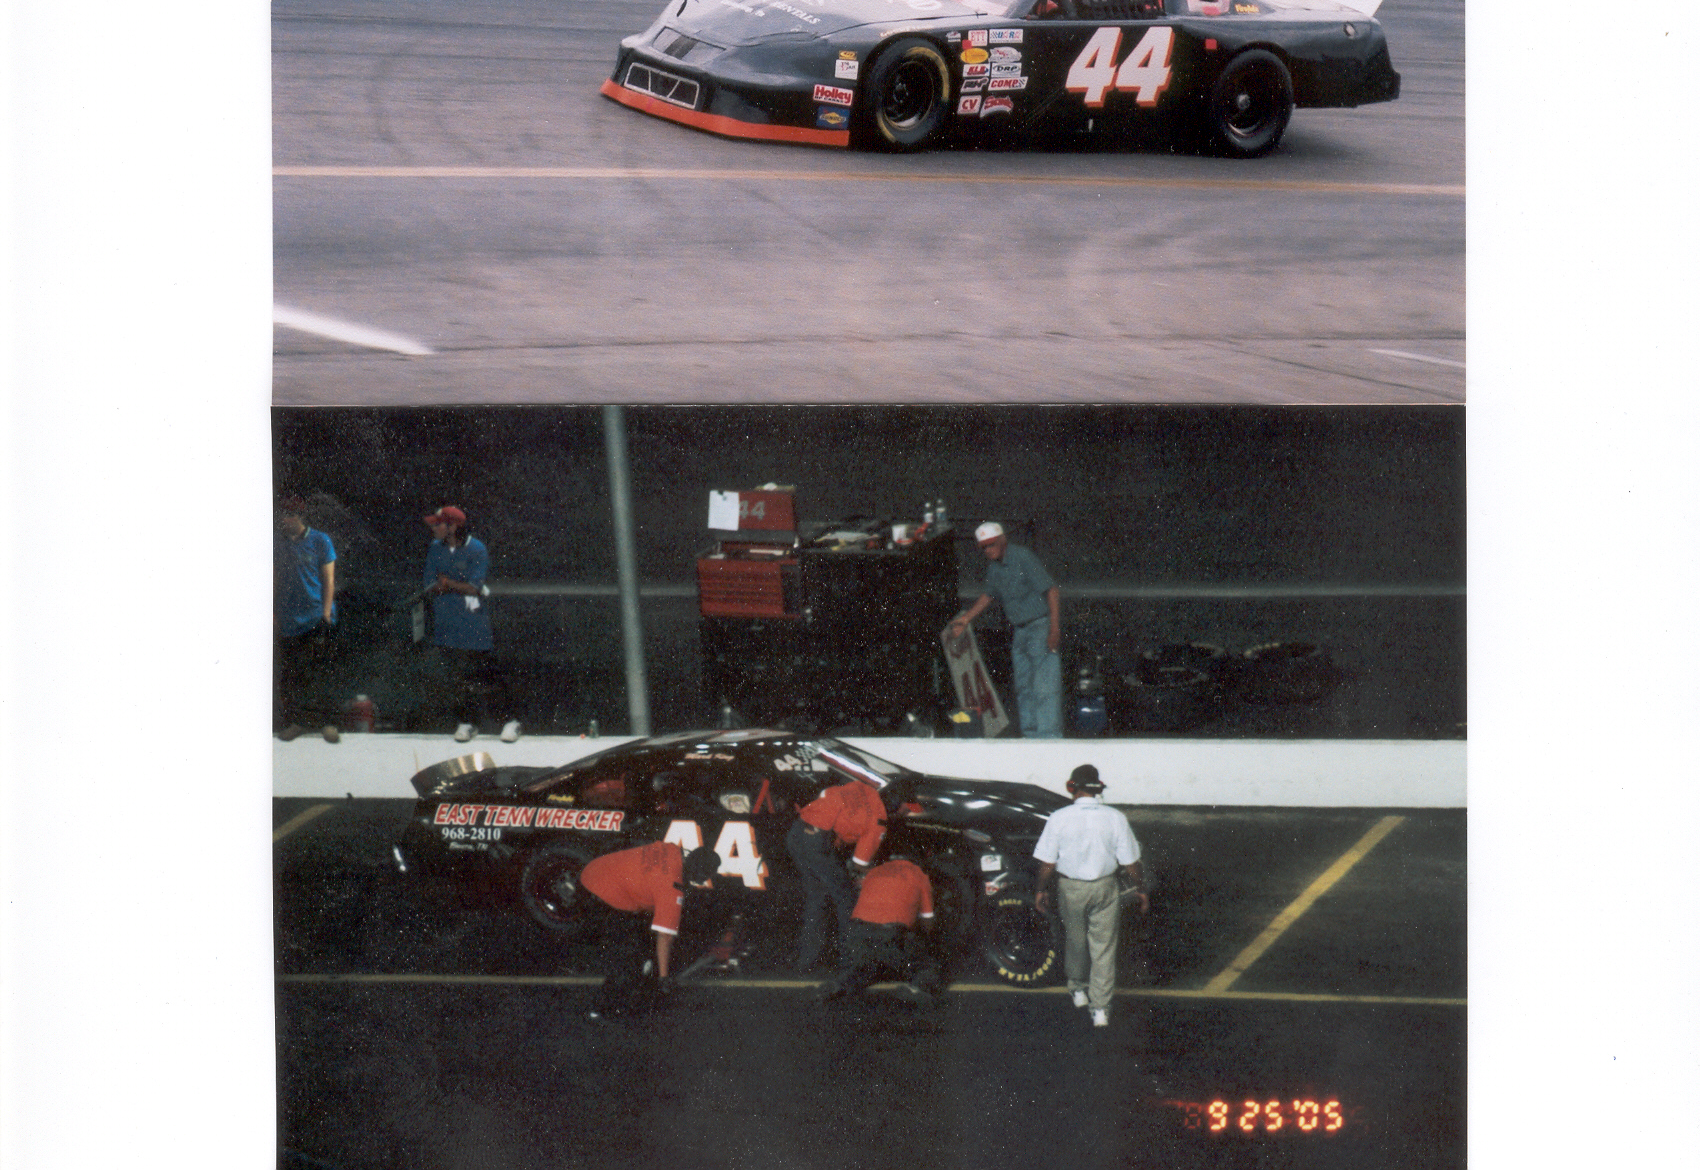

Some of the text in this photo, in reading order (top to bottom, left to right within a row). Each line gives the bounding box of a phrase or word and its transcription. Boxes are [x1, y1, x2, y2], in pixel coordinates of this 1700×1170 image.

[1065, 26, 1176, 108] 44
[990, 79, 1019, 88] COMP
[815, 85, 852, 104] Holley
[961, 98, 978, 110] CV
[434, 804, 625, 831] EAST TENN WRECKER
[441, 826, 501, 841] 968-2810
[998, 950, 1056, 982] GOODYEAR
